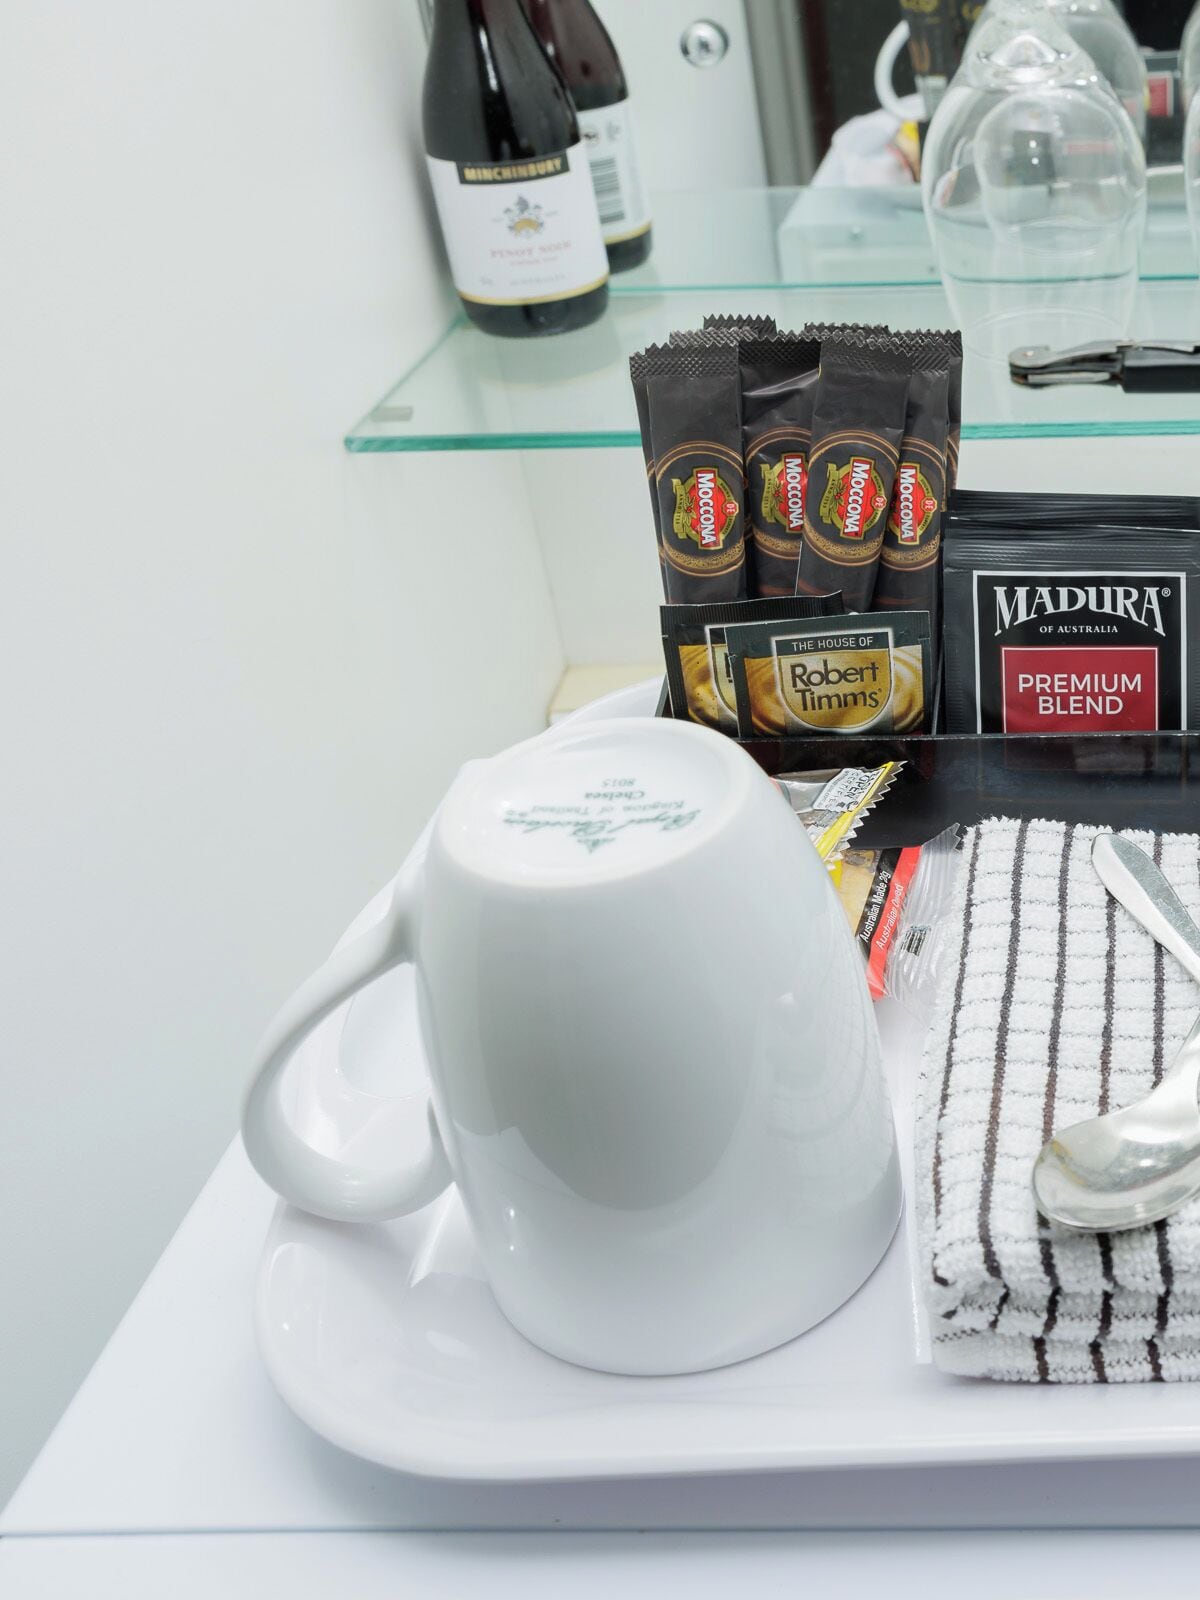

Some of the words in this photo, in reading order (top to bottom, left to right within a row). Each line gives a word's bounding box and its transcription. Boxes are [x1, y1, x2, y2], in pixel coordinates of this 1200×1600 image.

[697, 473, 717, 544] MOCCONA
[785, 458, 804, 528] MOCCONA
[844, 462, 870, 533] MOCCONA
[899, 468, 916, 539] MOCCONA
[993, 586, 1166, 637] MADURA
[1039, 625, 1054, 634] OF
[1057, 625, 1118, 634] AUSTRALIA
[791, 641, 814, 652] THE
[818, 638, 856, 649] HOUSE
[859, 636, 873, 647] OF
[791, 659, 879, 689] Robert
[1018, 673, 1142, 693] PREMIUM
[794, 688, 879, 711] Timms
[1038, 695, 1124, 715] BLEND
[584, 791, 645, 801] Chelsea
[859, 904, 881, 942] Australian
[871, 882, 887, 904] Made
[875, 907, 897, 950] Australian
